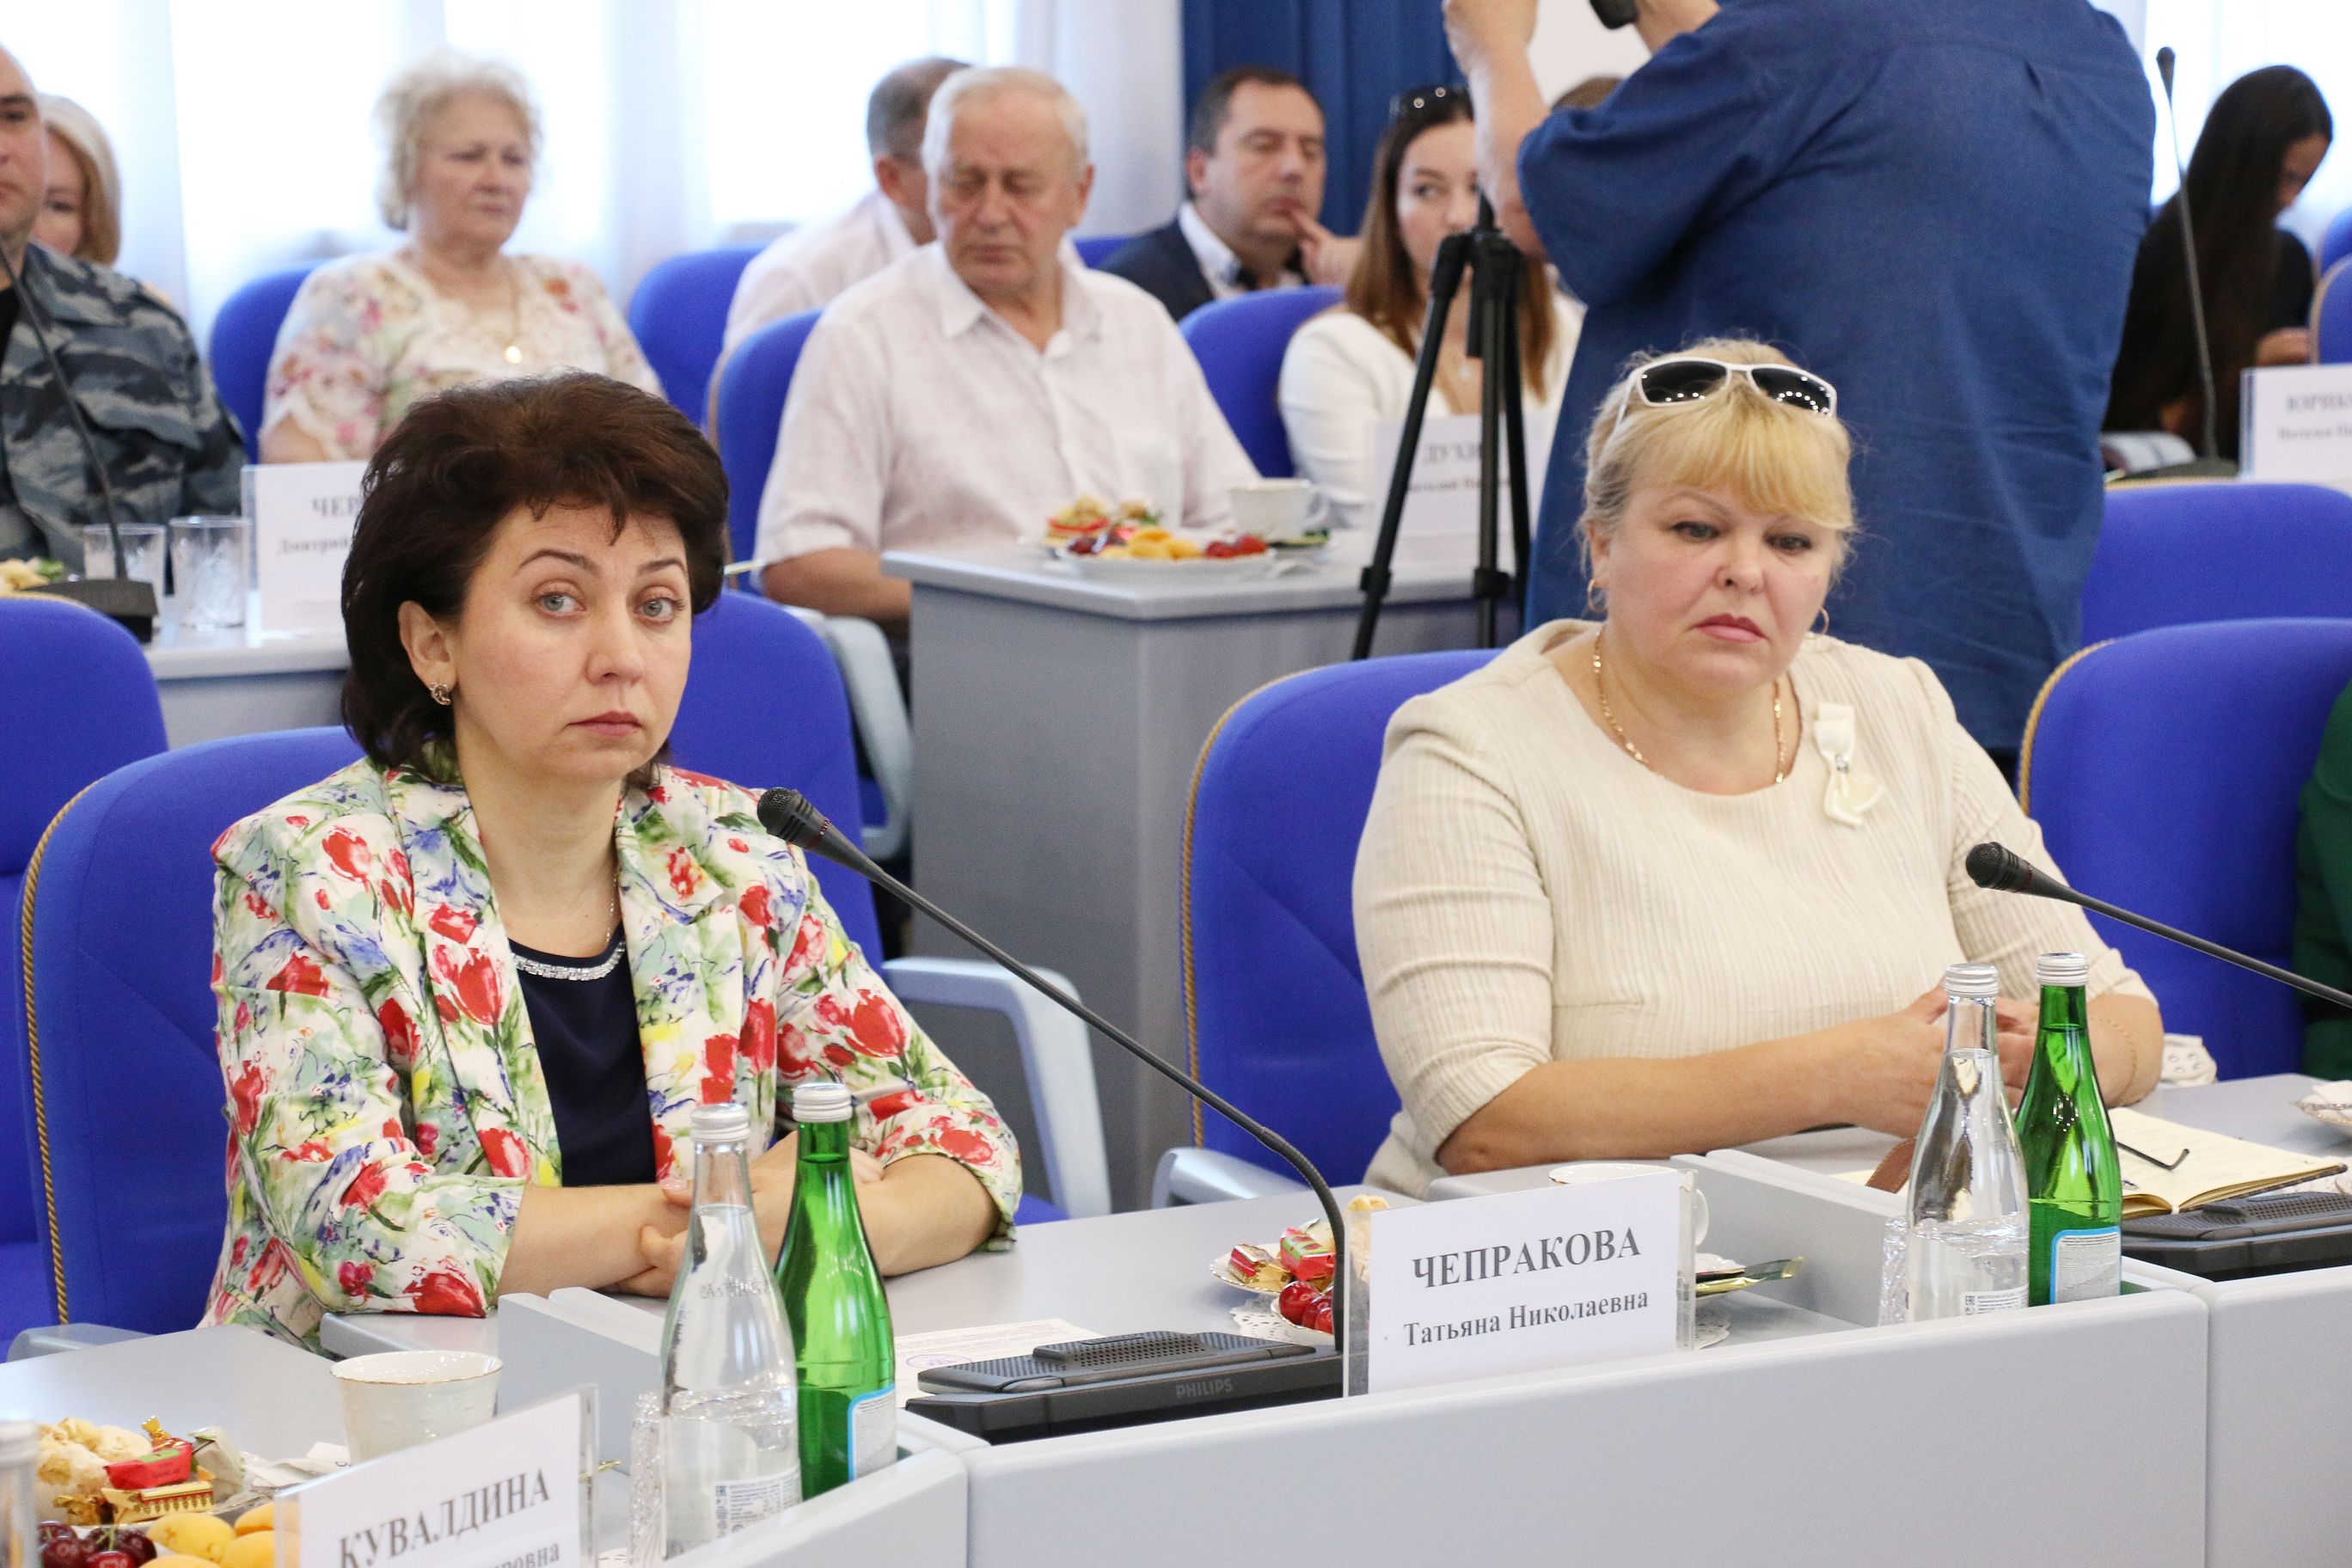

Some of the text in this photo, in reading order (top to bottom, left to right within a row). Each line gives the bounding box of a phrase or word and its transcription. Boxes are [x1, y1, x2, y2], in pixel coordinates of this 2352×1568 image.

[1411, 1227, 1641, 1288] ЧЕПРАКОВА
[1403, 1291, 1648, 1346] Татьяна Николаевна
[1175, 1377, 1233, 1399] PHILIPS
[337, 1467, 551, 1568] КУВАЛДИНА
